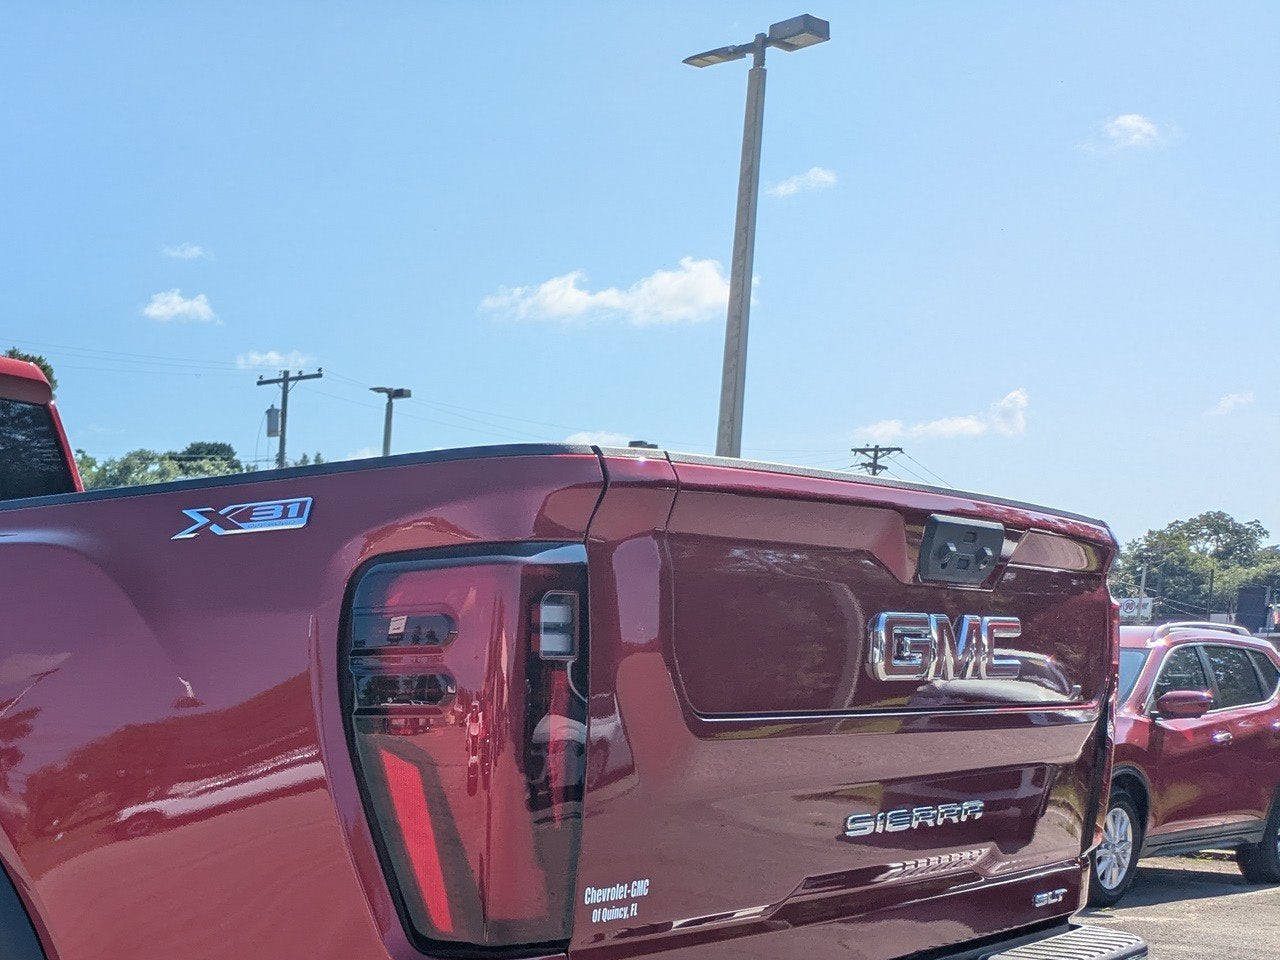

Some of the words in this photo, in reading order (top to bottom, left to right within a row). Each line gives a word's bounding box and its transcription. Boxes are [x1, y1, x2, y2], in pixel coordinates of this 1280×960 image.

[867, 612, 1022, 682] GMC
[844, 800, 985, 838] SIERRA
[1032, 887, 1069, 908] SLT
